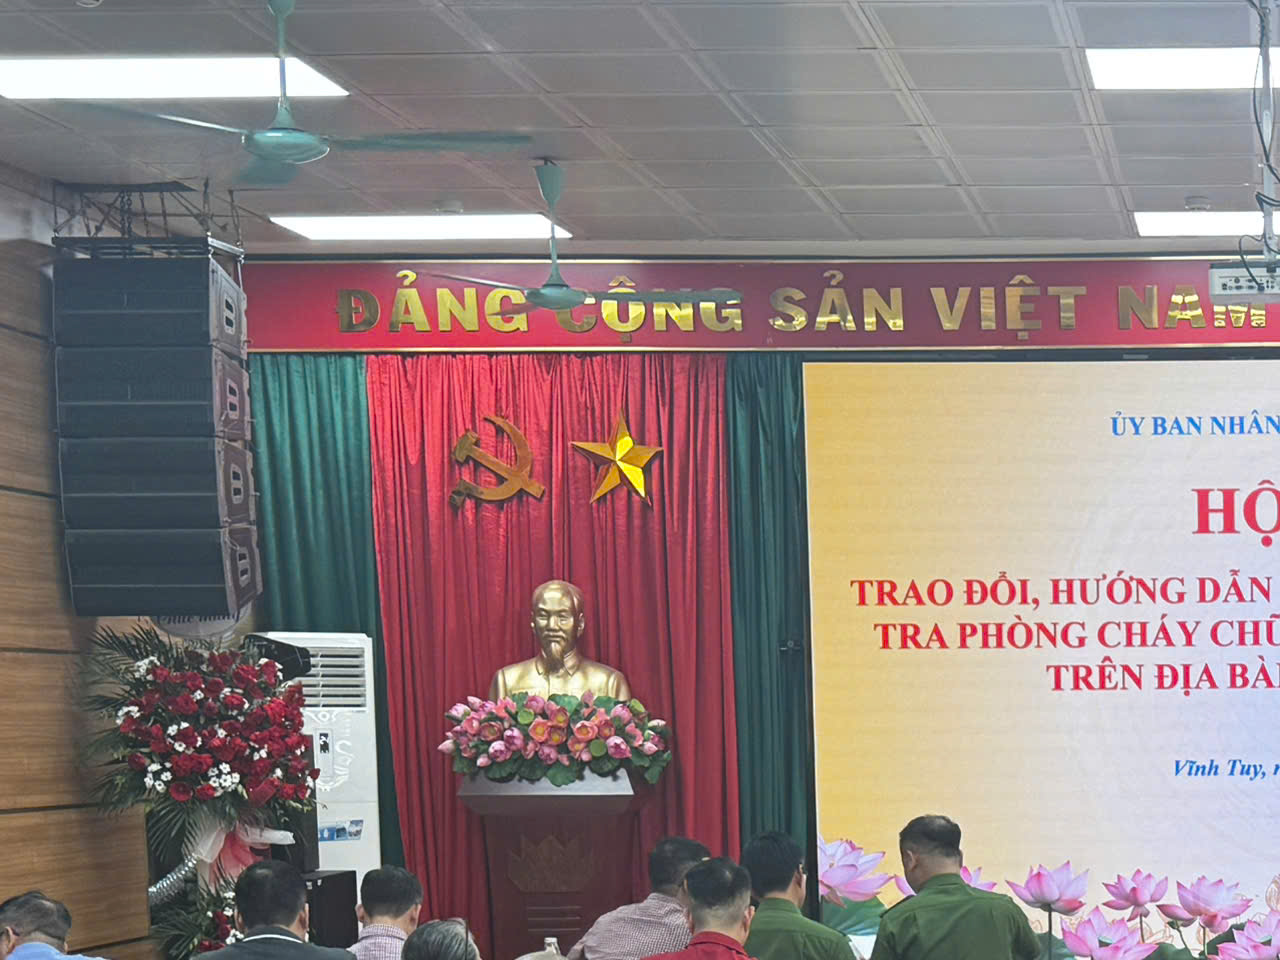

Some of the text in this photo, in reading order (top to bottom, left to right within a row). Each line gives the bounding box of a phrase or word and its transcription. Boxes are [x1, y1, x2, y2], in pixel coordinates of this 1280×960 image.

[337, 269, 529, 333] ĐẢNG
[768, 270, 904, 331] SẢN
[930, 274, 1087, 340] VIỆT
[1111, 411, 1144, 437] ỦY
[1151, 416, 1202, 435] BAN
[850, 579, 954, 607] TRAO
[963, 571, 1041, 609] ĐỔI,
[1049, 570, 1187, 606] HƯỚNG
[1196, 569, 1272, 605] DẪN
[873, 622, 952, 651] TRA
[957, 615, 1088, 651] PHÒNG
[1097, 614, 1201, 649] CHÁY
[1046, 655, 1143, 693] TRÊN
[1154, 663, 1219, 698] ĐỊA
[1173, 757, 1220, 777] Vĩnh
[1227, 757, 1268, 781] Tuy,
